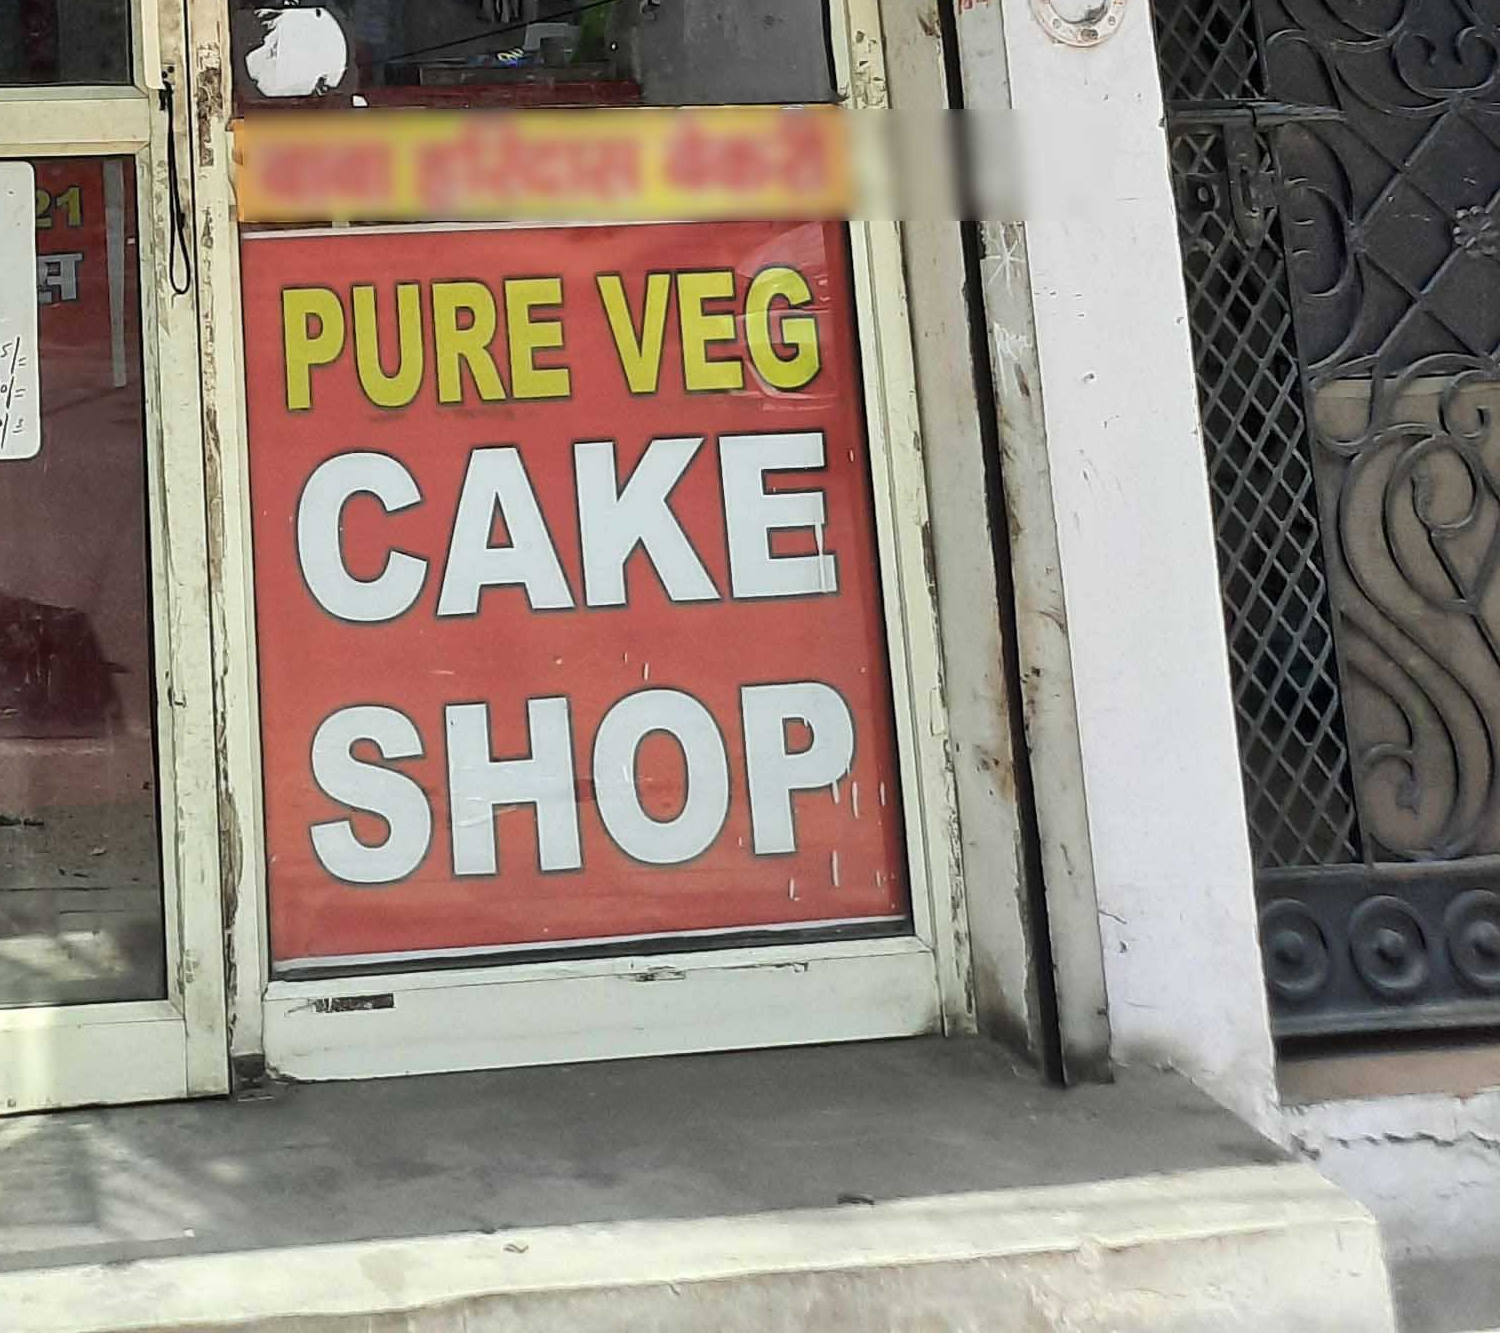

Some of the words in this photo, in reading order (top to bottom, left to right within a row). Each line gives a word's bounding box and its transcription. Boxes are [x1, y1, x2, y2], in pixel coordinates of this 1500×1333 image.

[282, 275, 573, 410] PURE
[596, 266, 823, 396] VEG
[296, 431, 841, 624] CAKE
[308, 679, 857, 887] SHOP
